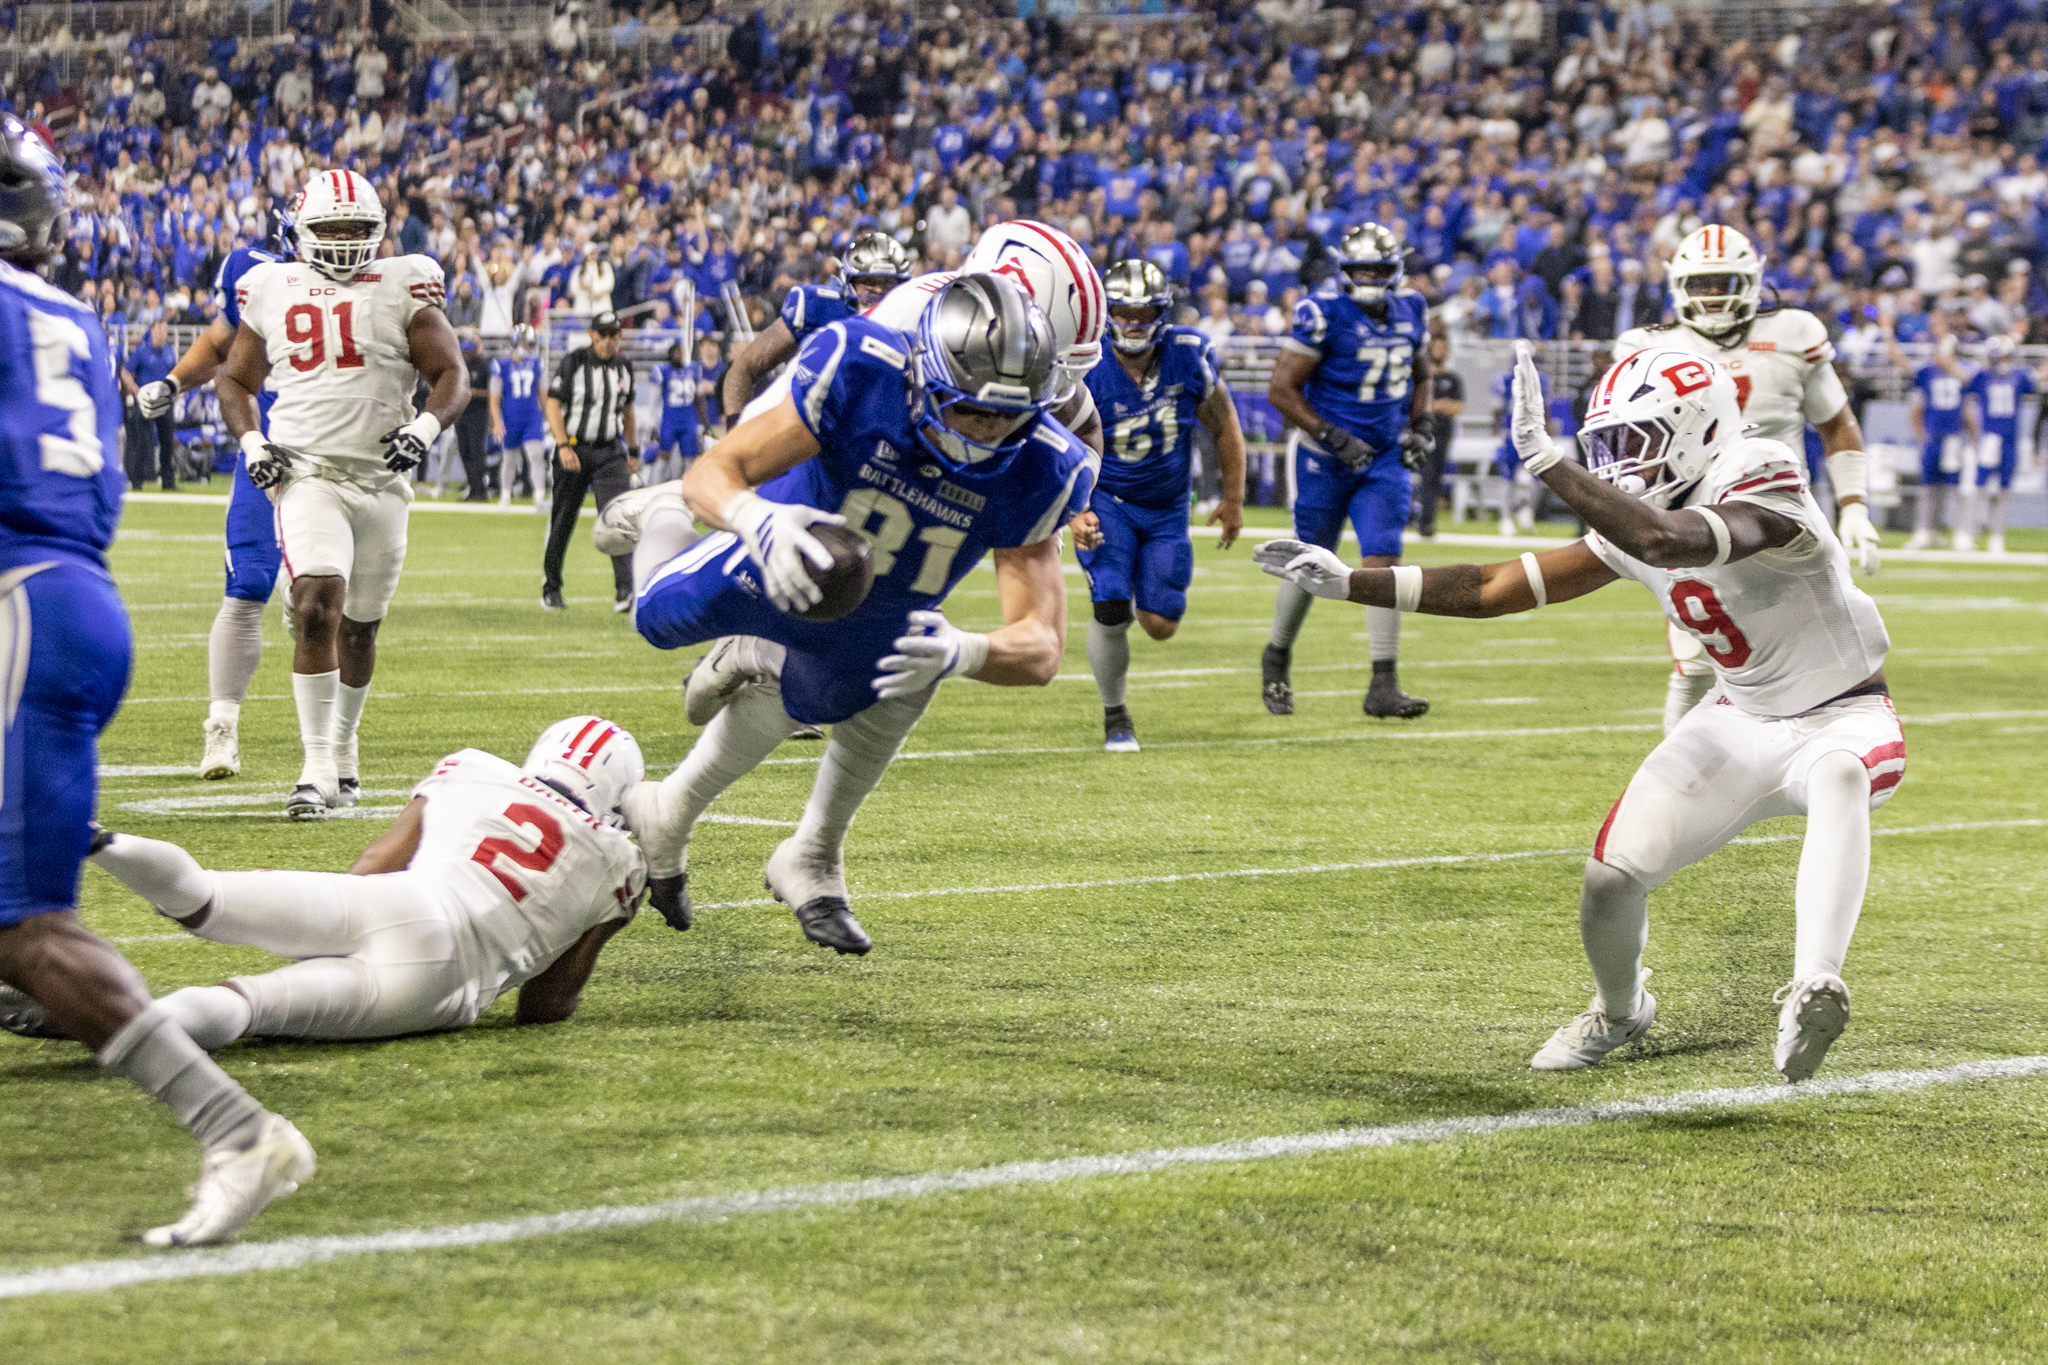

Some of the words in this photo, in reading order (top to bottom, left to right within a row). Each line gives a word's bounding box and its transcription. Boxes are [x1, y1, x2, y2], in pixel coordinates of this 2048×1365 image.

[309, 288, 336, 296] DC
[285, 301, 365, 373] 91
[510, 369, 534, 399] 17
[1112, 406, 1179, 463] 61
[858, 463, 974, 528] BATTLEHAWKS
[840, 487, 969, 596] 81
[1669, 579, 1753, 668] 9
[471, 802, 566, 903] 2
